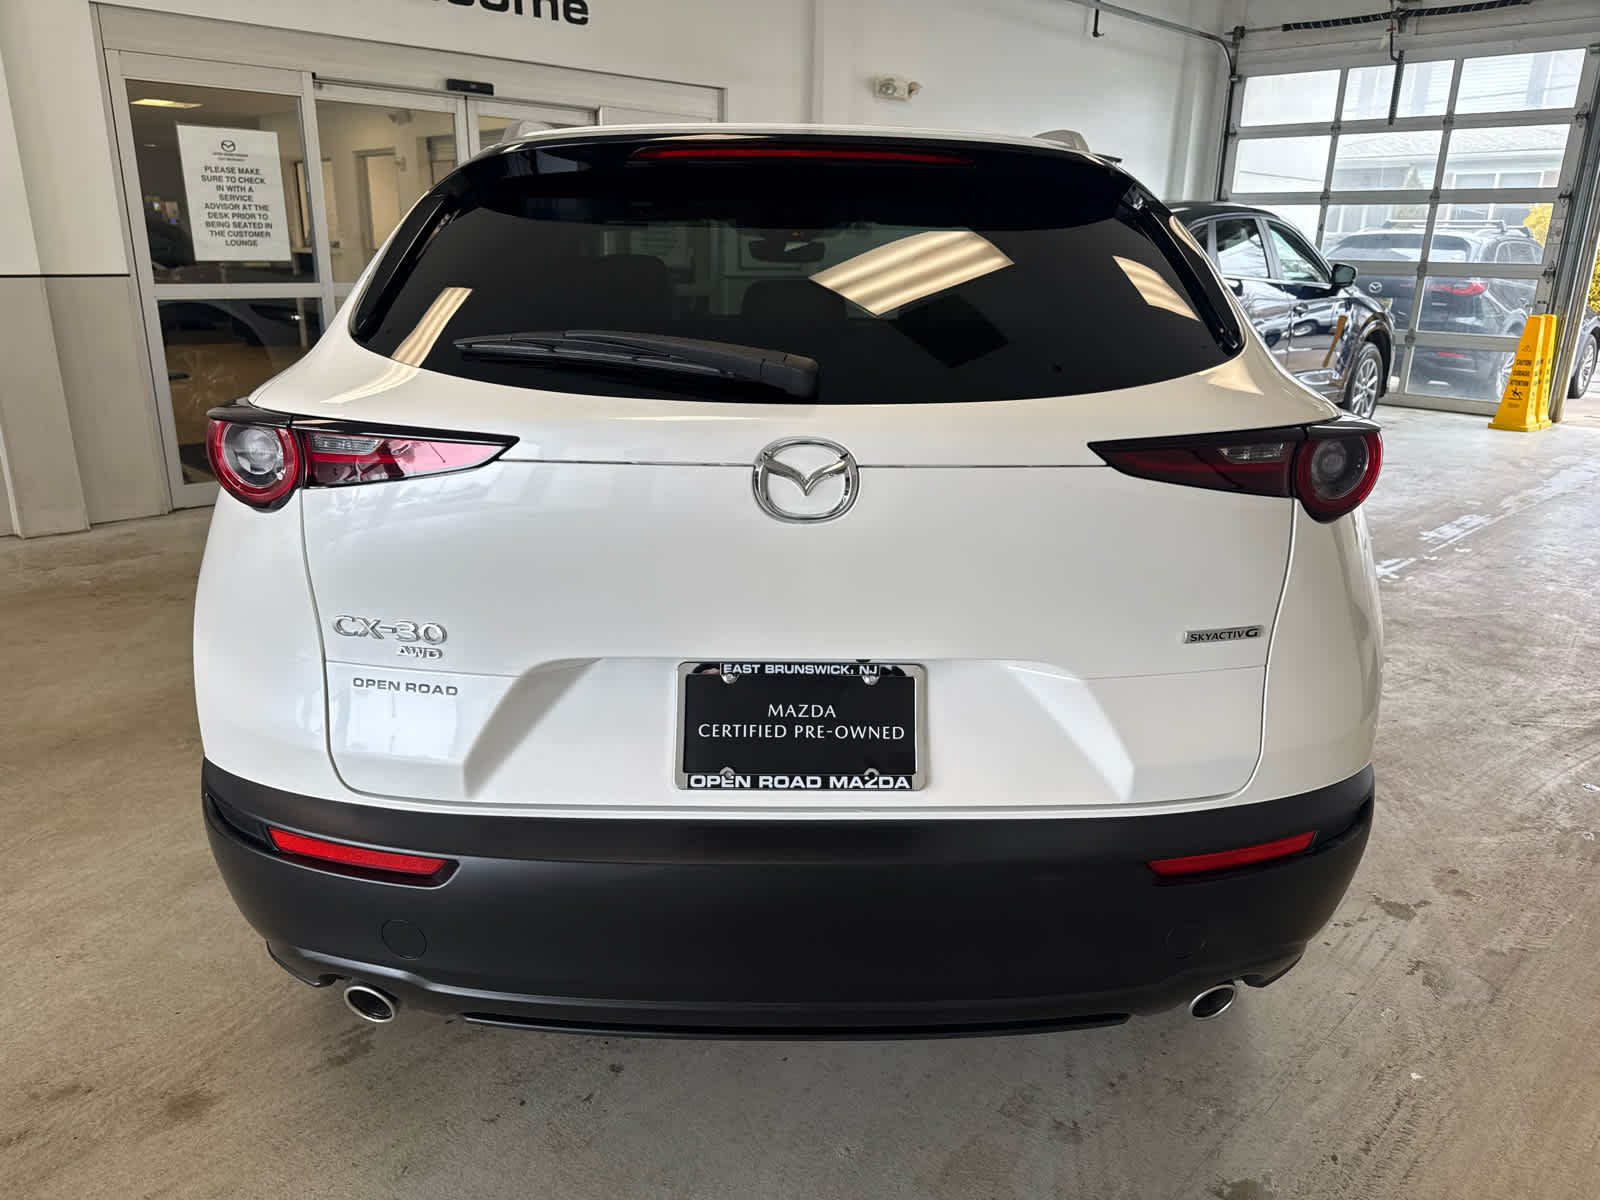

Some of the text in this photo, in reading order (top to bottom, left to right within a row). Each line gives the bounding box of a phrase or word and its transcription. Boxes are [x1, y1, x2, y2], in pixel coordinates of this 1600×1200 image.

[204, 165, 236, 174] PLEASE
[201, 175, 223, 183] SURE
[239, 176, 266, 184] CHECK
[219, 194, 253, 202] SERVICE
[205, 202, 240, 210] ADVISOR
[254, 204, 270, 212] THE
[232, 212, 256, 220] PRIOR
[258, 213, 268, 221] TO
[205, 221, 230, 229] BEING
[232, 221, 263, 229] SEATED
[228, 230, 271, 238] CUSTOMER
[334, 615, 447, 645] CX-30
[398, 645, 443, 659] AWD
[723, 664, 878, 676] EAST BRUNSWICK, NJ
[353, 677, 458, 696] OPEN ROAD
[767, 704, 837, 718] MAZDA
[698, 724, 905, 740] CERTIFIED PRE-OWNED
[690, 775, 911, 789] OPEN ROAD MAZDA
